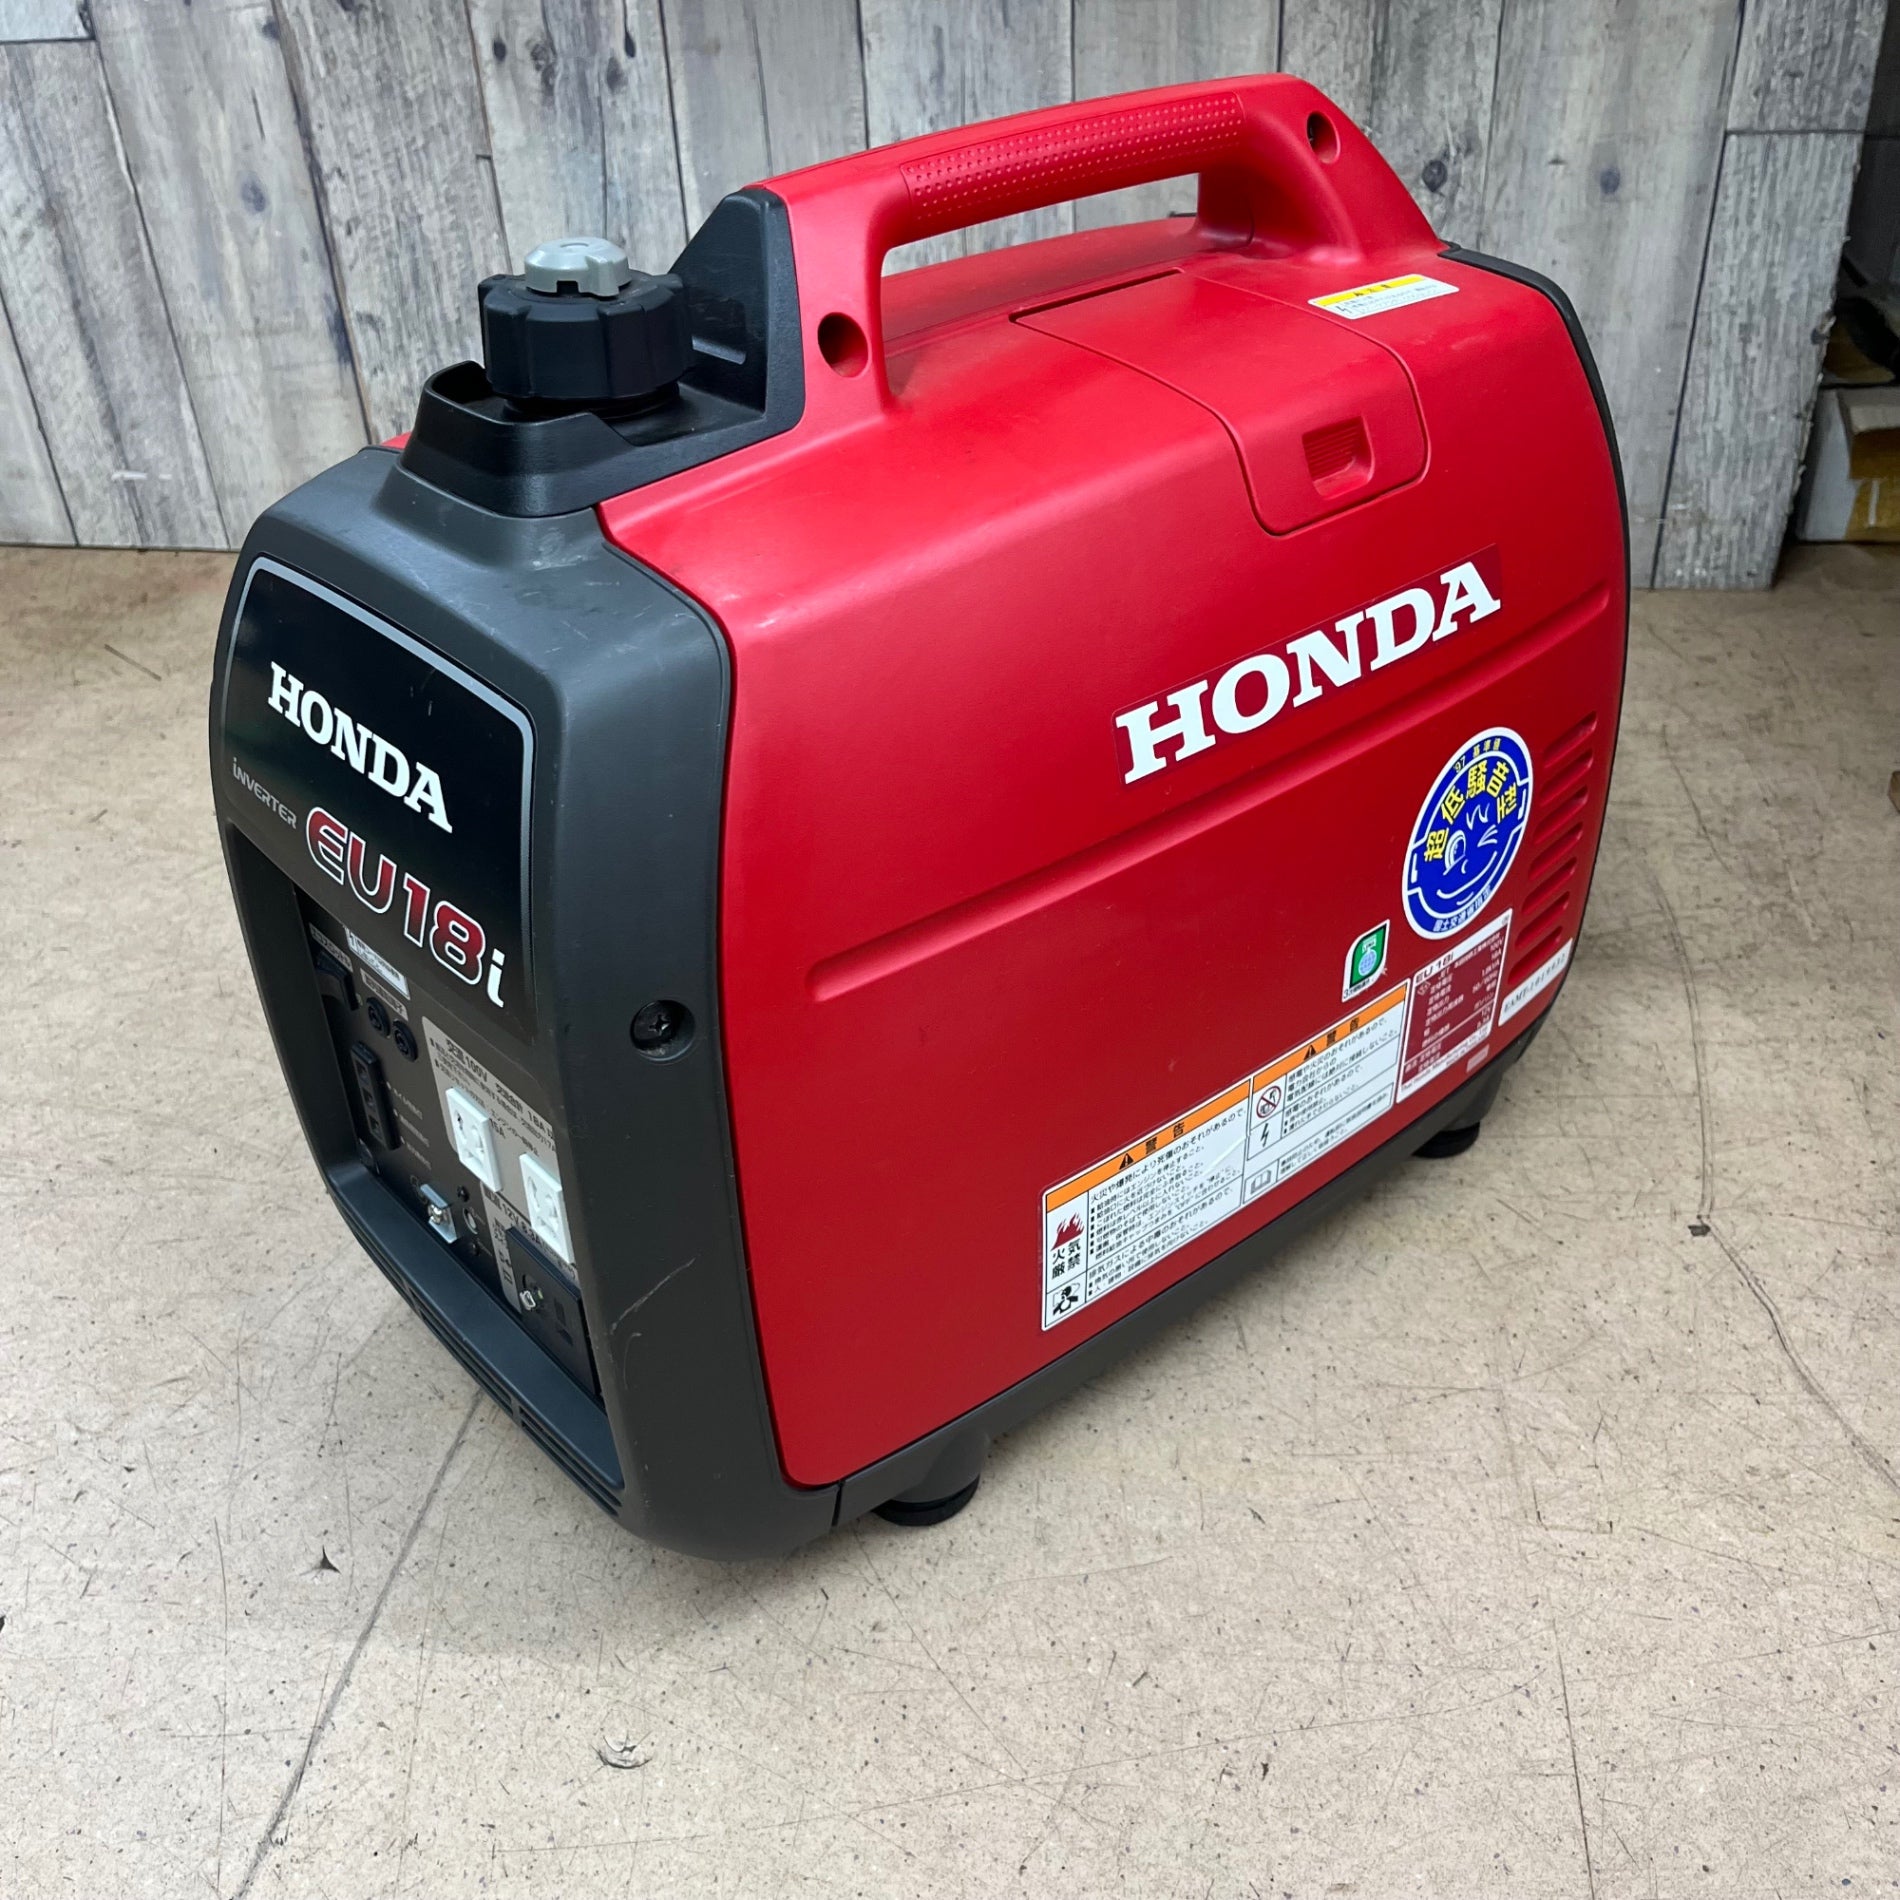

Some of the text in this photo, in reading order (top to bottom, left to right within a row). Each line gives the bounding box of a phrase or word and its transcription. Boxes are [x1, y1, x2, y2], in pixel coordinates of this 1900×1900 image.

[1116, 563, 1502, 783] HONDA
[267, 661, 453, 833] HONDA
[1423, 759, 1517, 863] 超低騒音型
[306, 806, 505, 1007] EU18i
[1144, 1120, 1185, 1155] 警告
[1052, 1242, 1081, 1264] 火気
[1052, 1255, 1081, 1279] 厳禁
